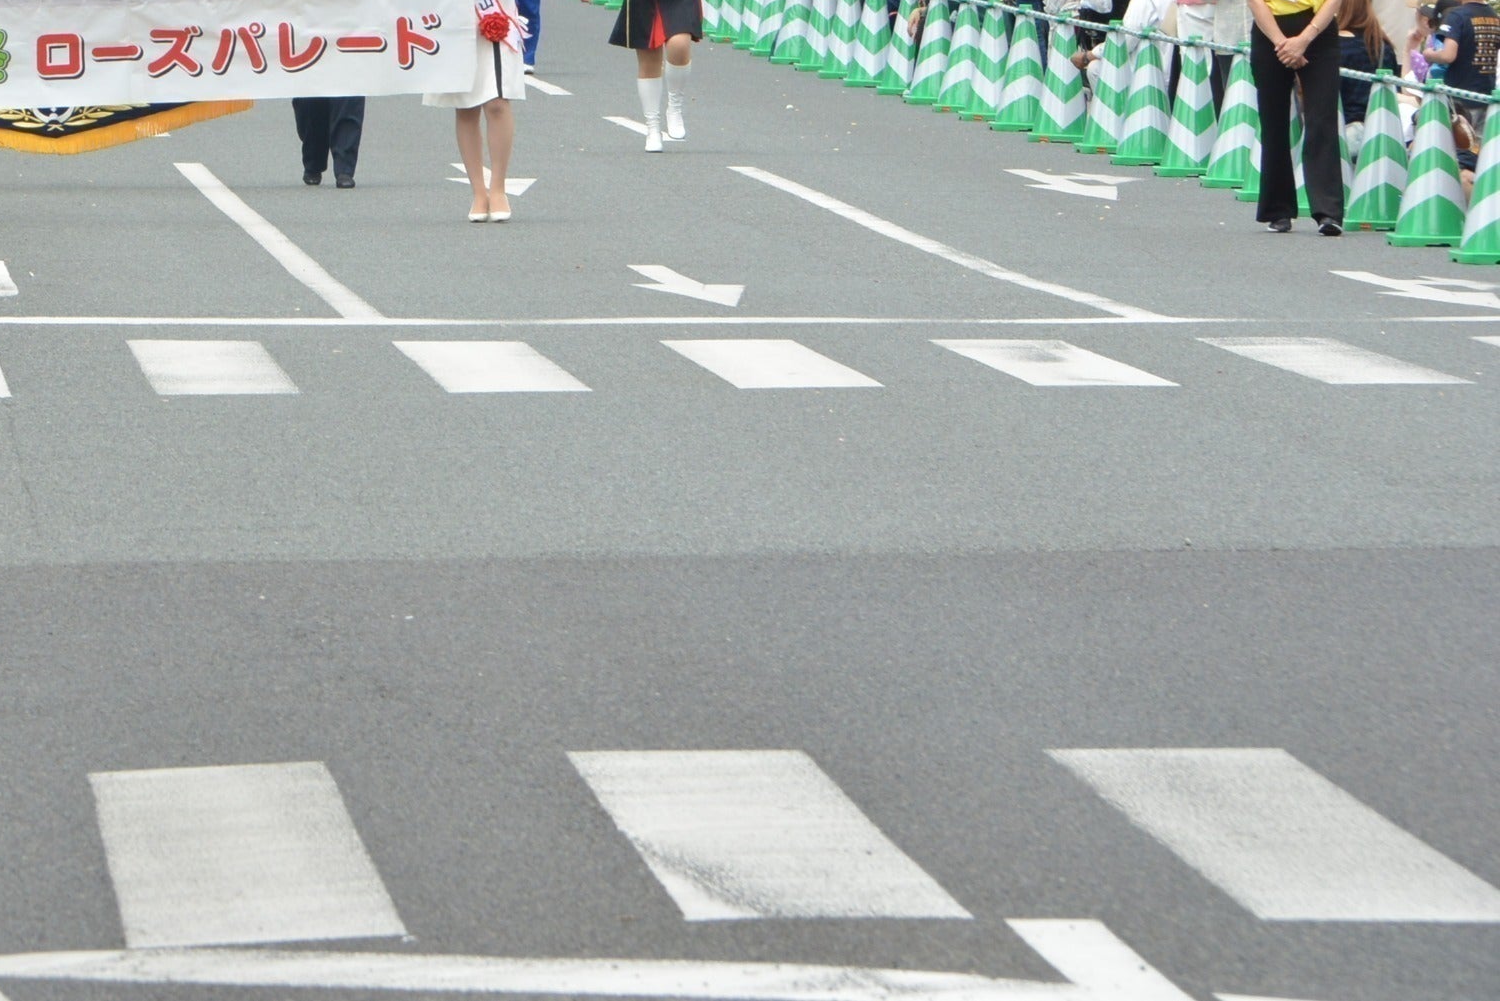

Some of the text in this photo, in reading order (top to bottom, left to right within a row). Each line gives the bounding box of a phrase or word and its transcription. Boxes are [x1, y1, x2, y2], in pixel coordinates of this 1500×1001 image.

[35, 13, 442, 81] ローズパレード
